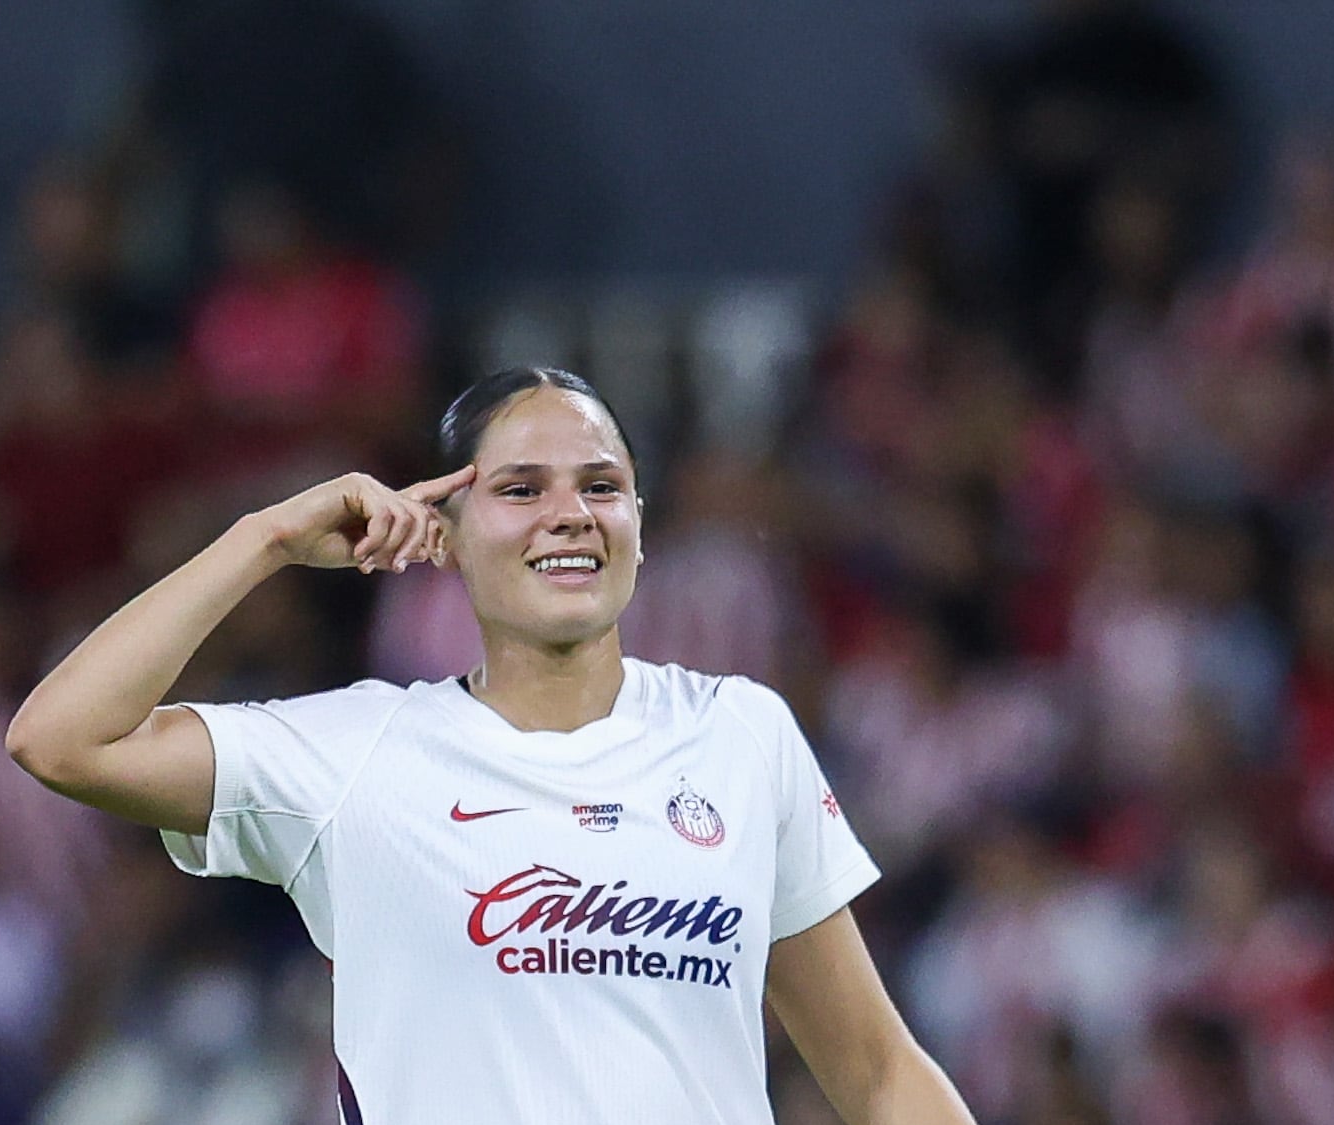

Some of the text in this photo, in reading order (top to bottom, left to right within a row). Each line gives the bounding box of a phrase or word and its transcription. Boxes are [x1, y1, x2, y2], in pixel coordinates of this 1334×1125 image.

[571, 803, 624, 815] amazon
[578, 815, 619, 828] prime
[464, 863, 743, 946] Caliente
[496, 938, 733, 990] caliente.mx
